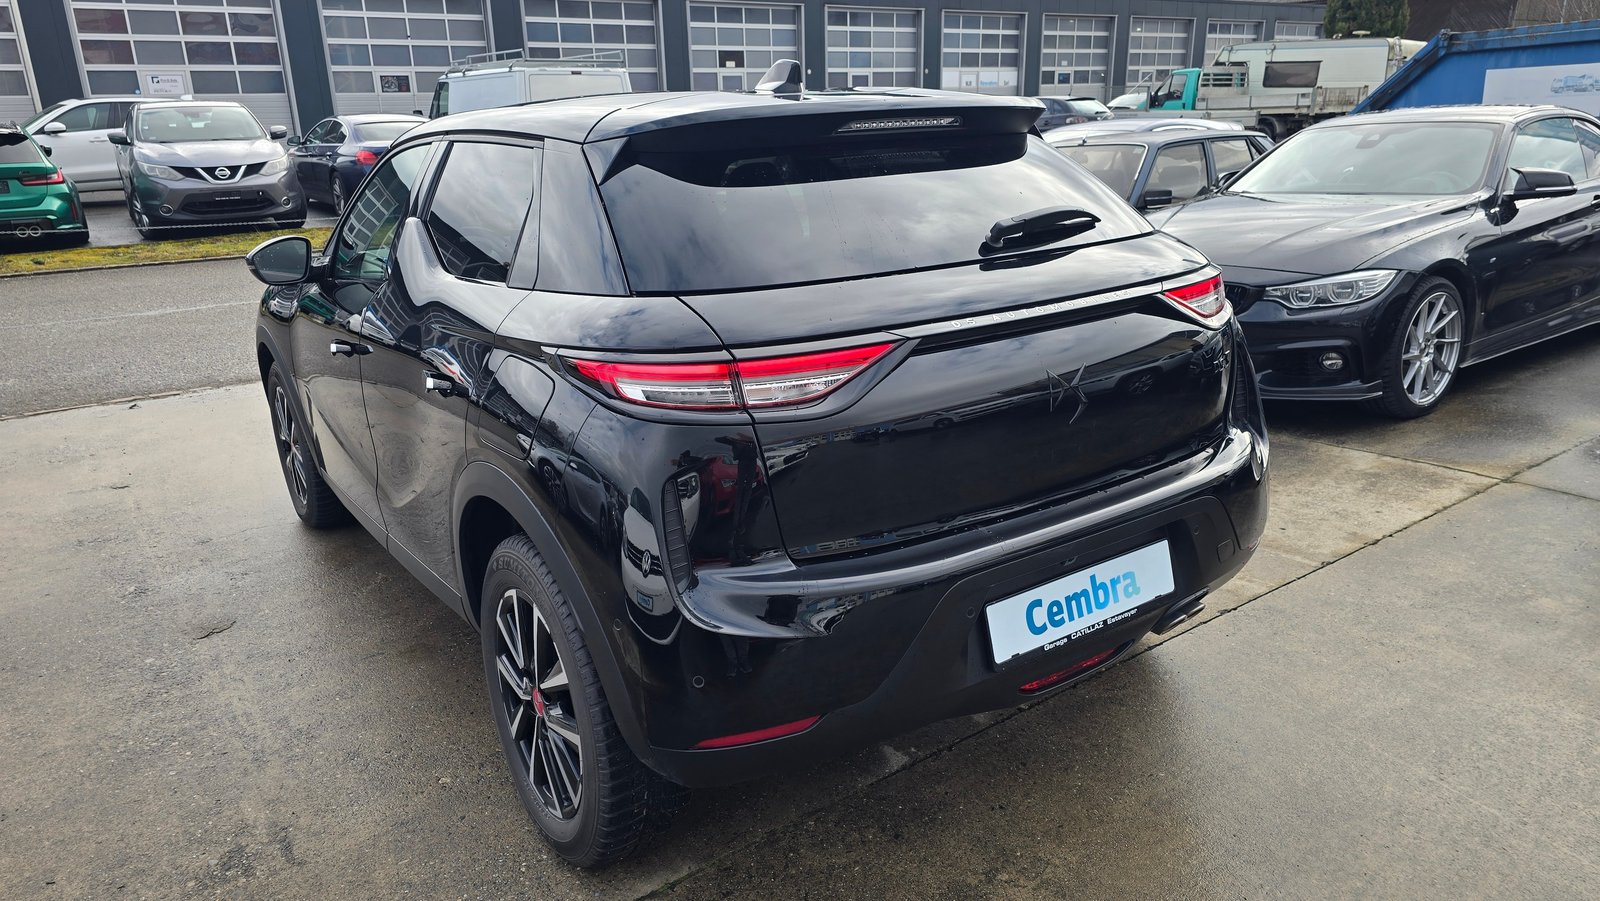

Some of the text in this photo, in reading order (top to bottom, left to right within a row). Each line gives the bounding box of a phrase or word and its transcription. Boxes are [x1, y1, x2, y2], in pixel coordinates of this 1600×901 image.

[952, 292, 1130, 328] DS AUTOMOBILES
[1026, 571, 1140, 635] Cembra
[1044, 608, 1138, 651] Garage CATILLAZ Estavayer
